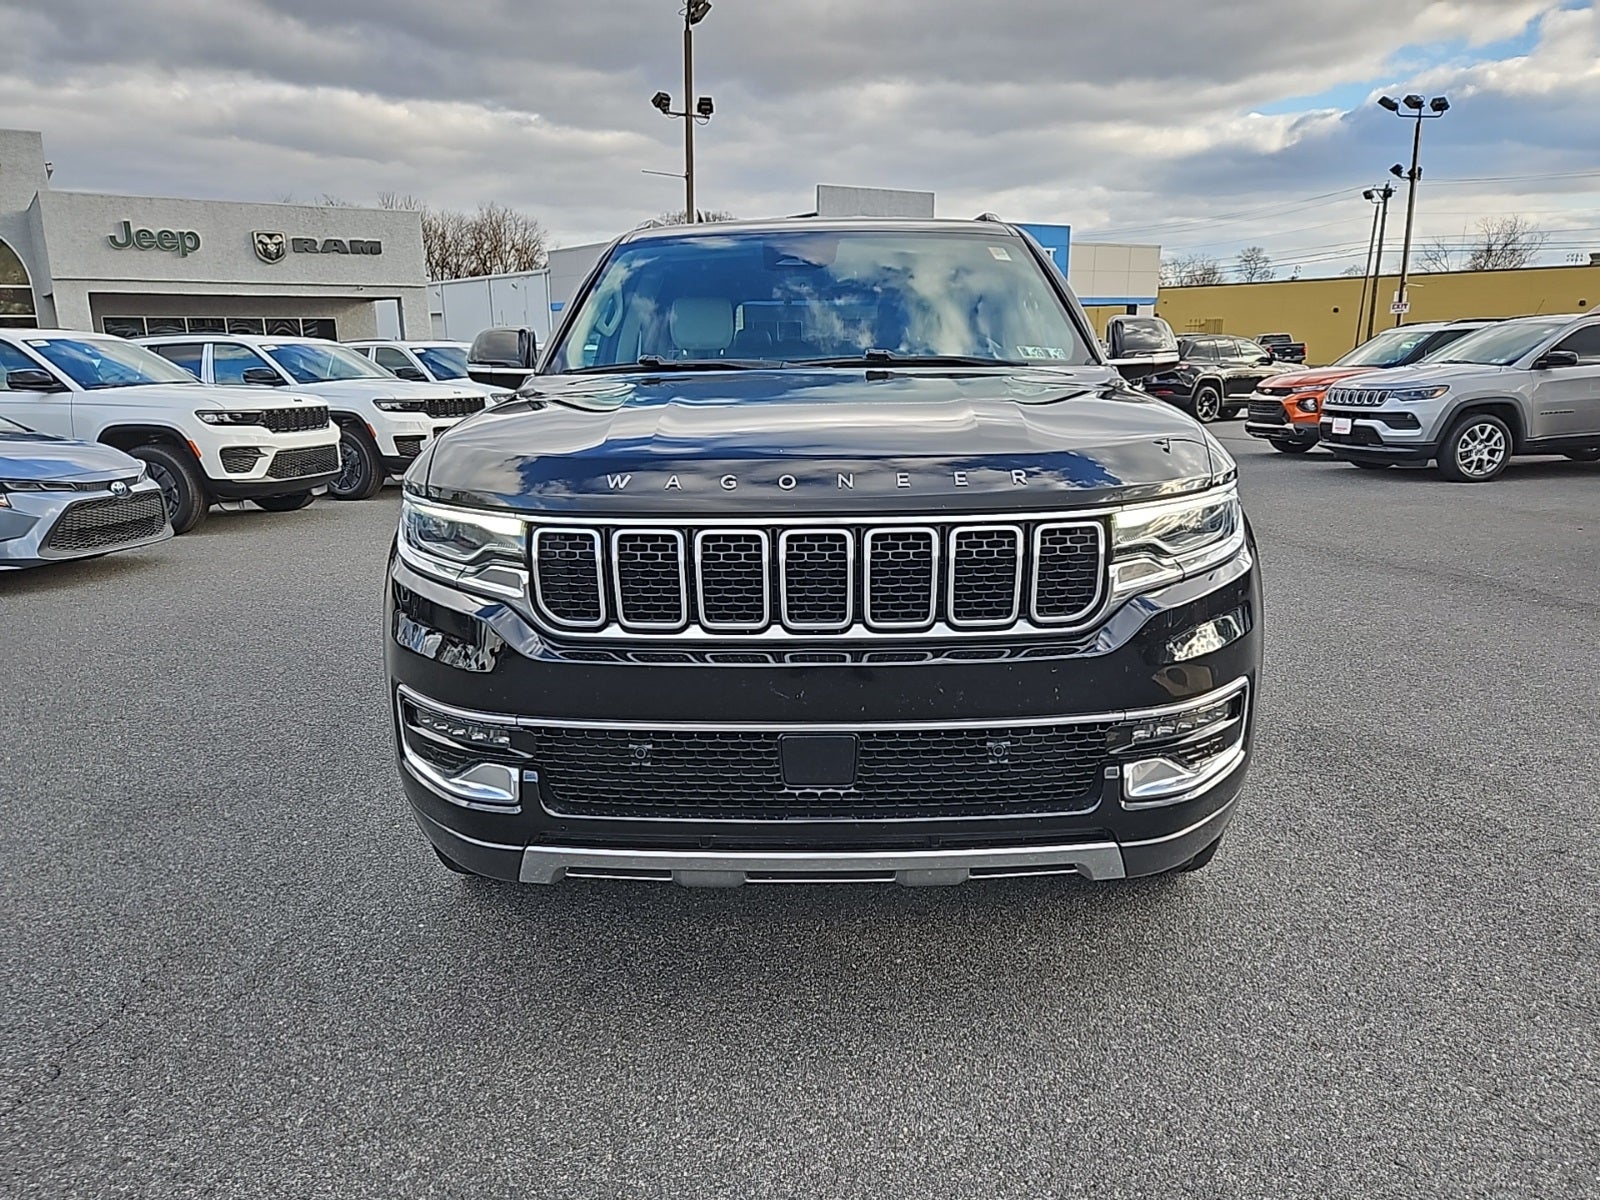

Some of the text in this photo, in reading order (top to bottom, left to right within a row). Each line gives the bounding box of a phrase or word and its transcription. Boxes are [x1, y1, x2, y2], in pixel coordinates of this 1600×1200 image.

[107, 220, 201, 257] Jeep
[291, 237, 382, 255] RAM
[606, 469, 1030, 491] WAGONEER
